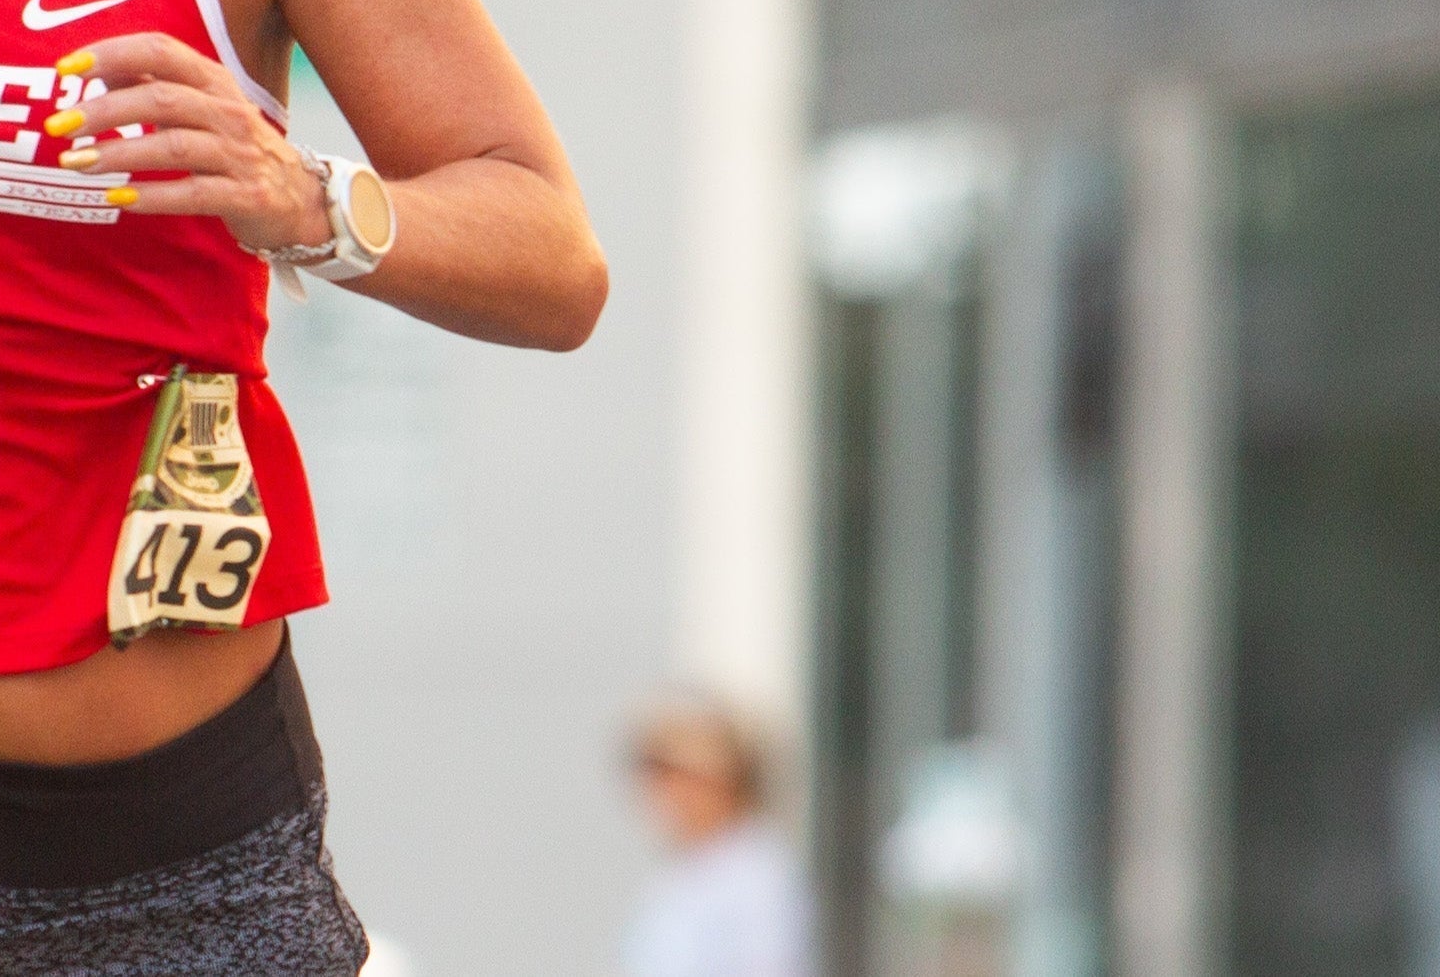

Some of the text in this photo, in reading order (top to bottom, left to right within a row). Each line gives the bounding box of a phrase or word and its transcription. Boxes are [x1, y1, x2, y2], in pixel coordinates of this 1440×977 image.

[8, 184, 107, 204] RACIN
[22, 204, 114, 220] TEAM
[125, 523, 262, 610] 413
